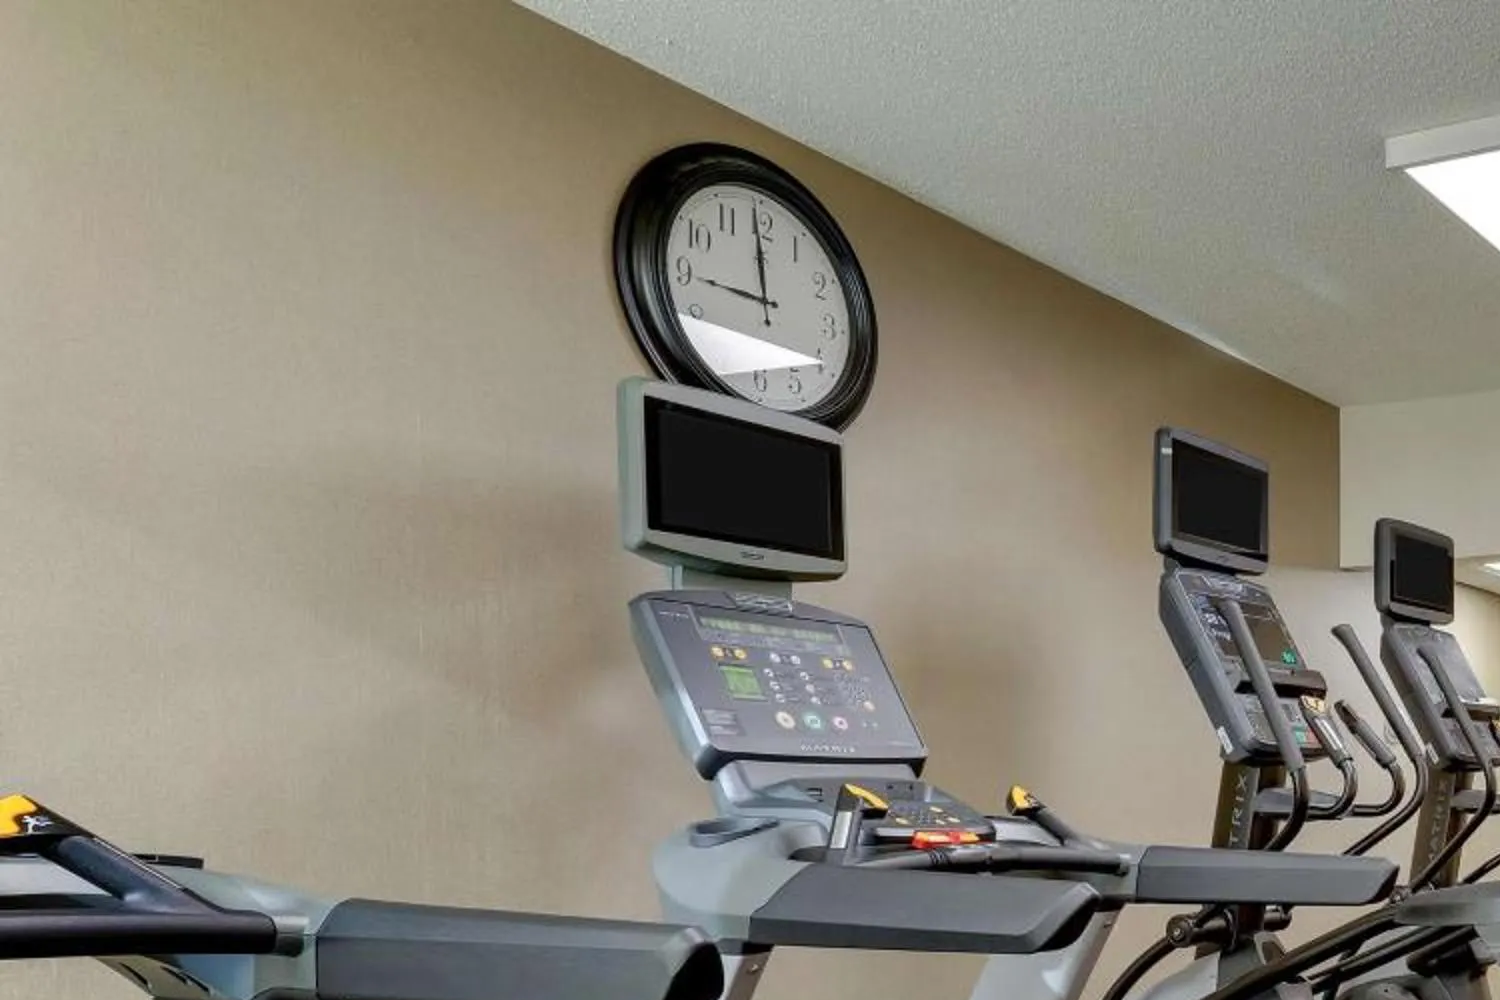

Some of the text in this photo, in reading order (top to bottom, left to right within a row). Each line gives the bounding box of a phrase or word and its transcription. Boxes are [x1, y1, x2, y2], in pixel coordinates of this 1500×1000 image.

[688, 218, 712, 252] 10
[719, 203, 736, 237] 11
[792, 235, 799, 263] 1
[675, 255, 693, 287] 9
[811, 270, 827, 301] 2
[822, 312, 838, 341] 3
